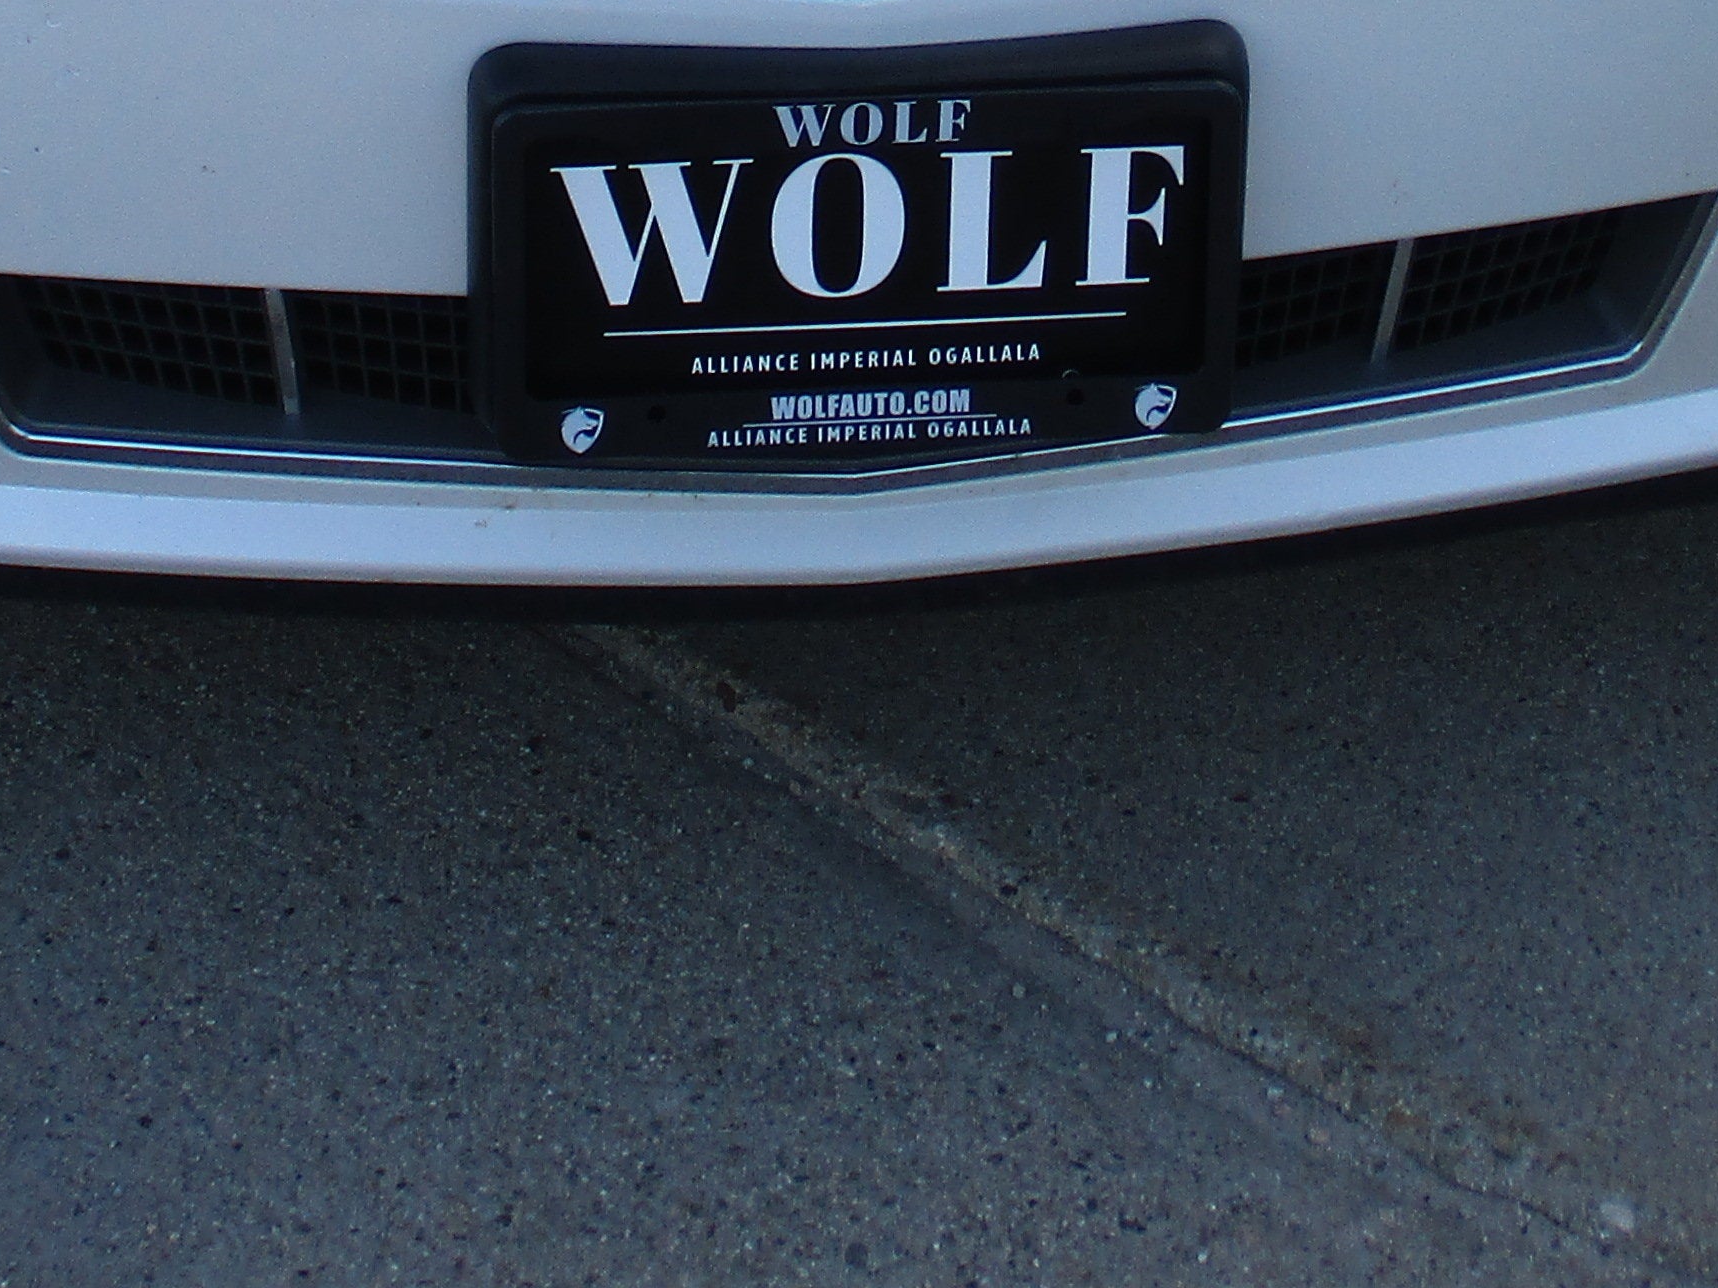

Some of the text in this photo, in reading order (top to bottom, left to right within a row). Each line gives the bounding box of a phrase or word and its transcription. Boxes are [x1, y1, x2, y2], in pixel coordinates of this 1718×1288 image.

[774, 99, 972, 148] WOLF
[549, 145, 1185, 306] WOLF
[691, 343, 1041, 375] ALLIANCE IMPERIAL OGALLALA
[770, 388, 971, 421] WOLFAUTO.COM
[707, 418, 1032, 448] ALLIANCE IMPERIAL OGALLALA
